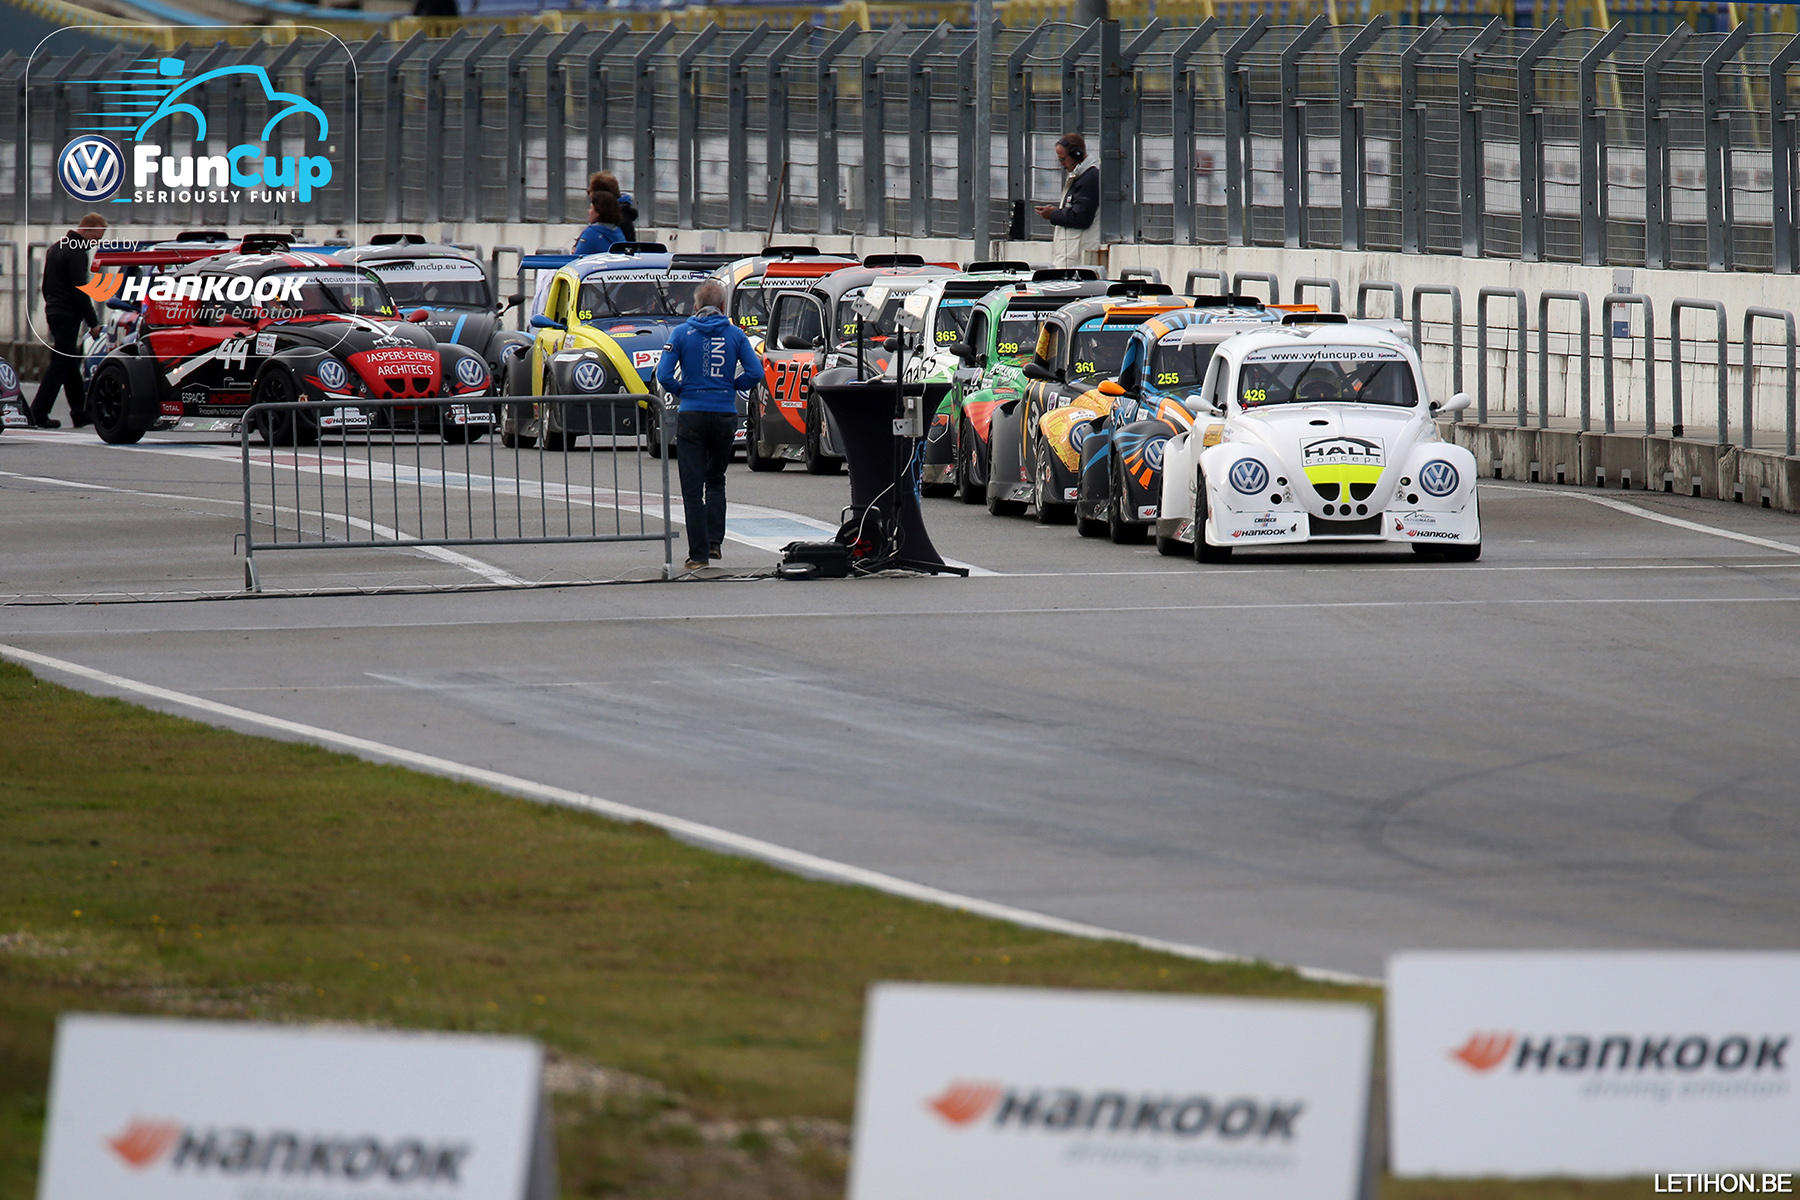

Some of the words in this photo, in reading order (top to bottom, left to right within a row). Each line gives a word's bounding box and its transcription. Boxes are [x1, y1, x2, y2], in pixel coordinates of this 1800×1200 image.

[380, 305, 394, 315] 44
[579, 310, 592, 320] 65
[740, 316, 758, 326] 415
[936, 331, 957, 342] 365
[998, 343, 1018, 353] 299
[366, 350, 435, 363] JASPERS-EYERS
[702, 336, 711, 377] SERIOUSLY
[711, 337, 726, 378] FUN!
[1271, 351, 1374, 362] www.vwfuncup.eu
[378, 364, 434, 376] ARCHITECTS
[1076, 362, 1095, 373] 361
[1157, 373, 1180, 385] 255
[182, 393, 206, 403] ESPACE
[1243, 389, 1266, 401] 426
[162, 404, 180, 412] TOTAL
[1304, 447, 1381, 458] HALL
[1305, 455, 1381, 464] concept
